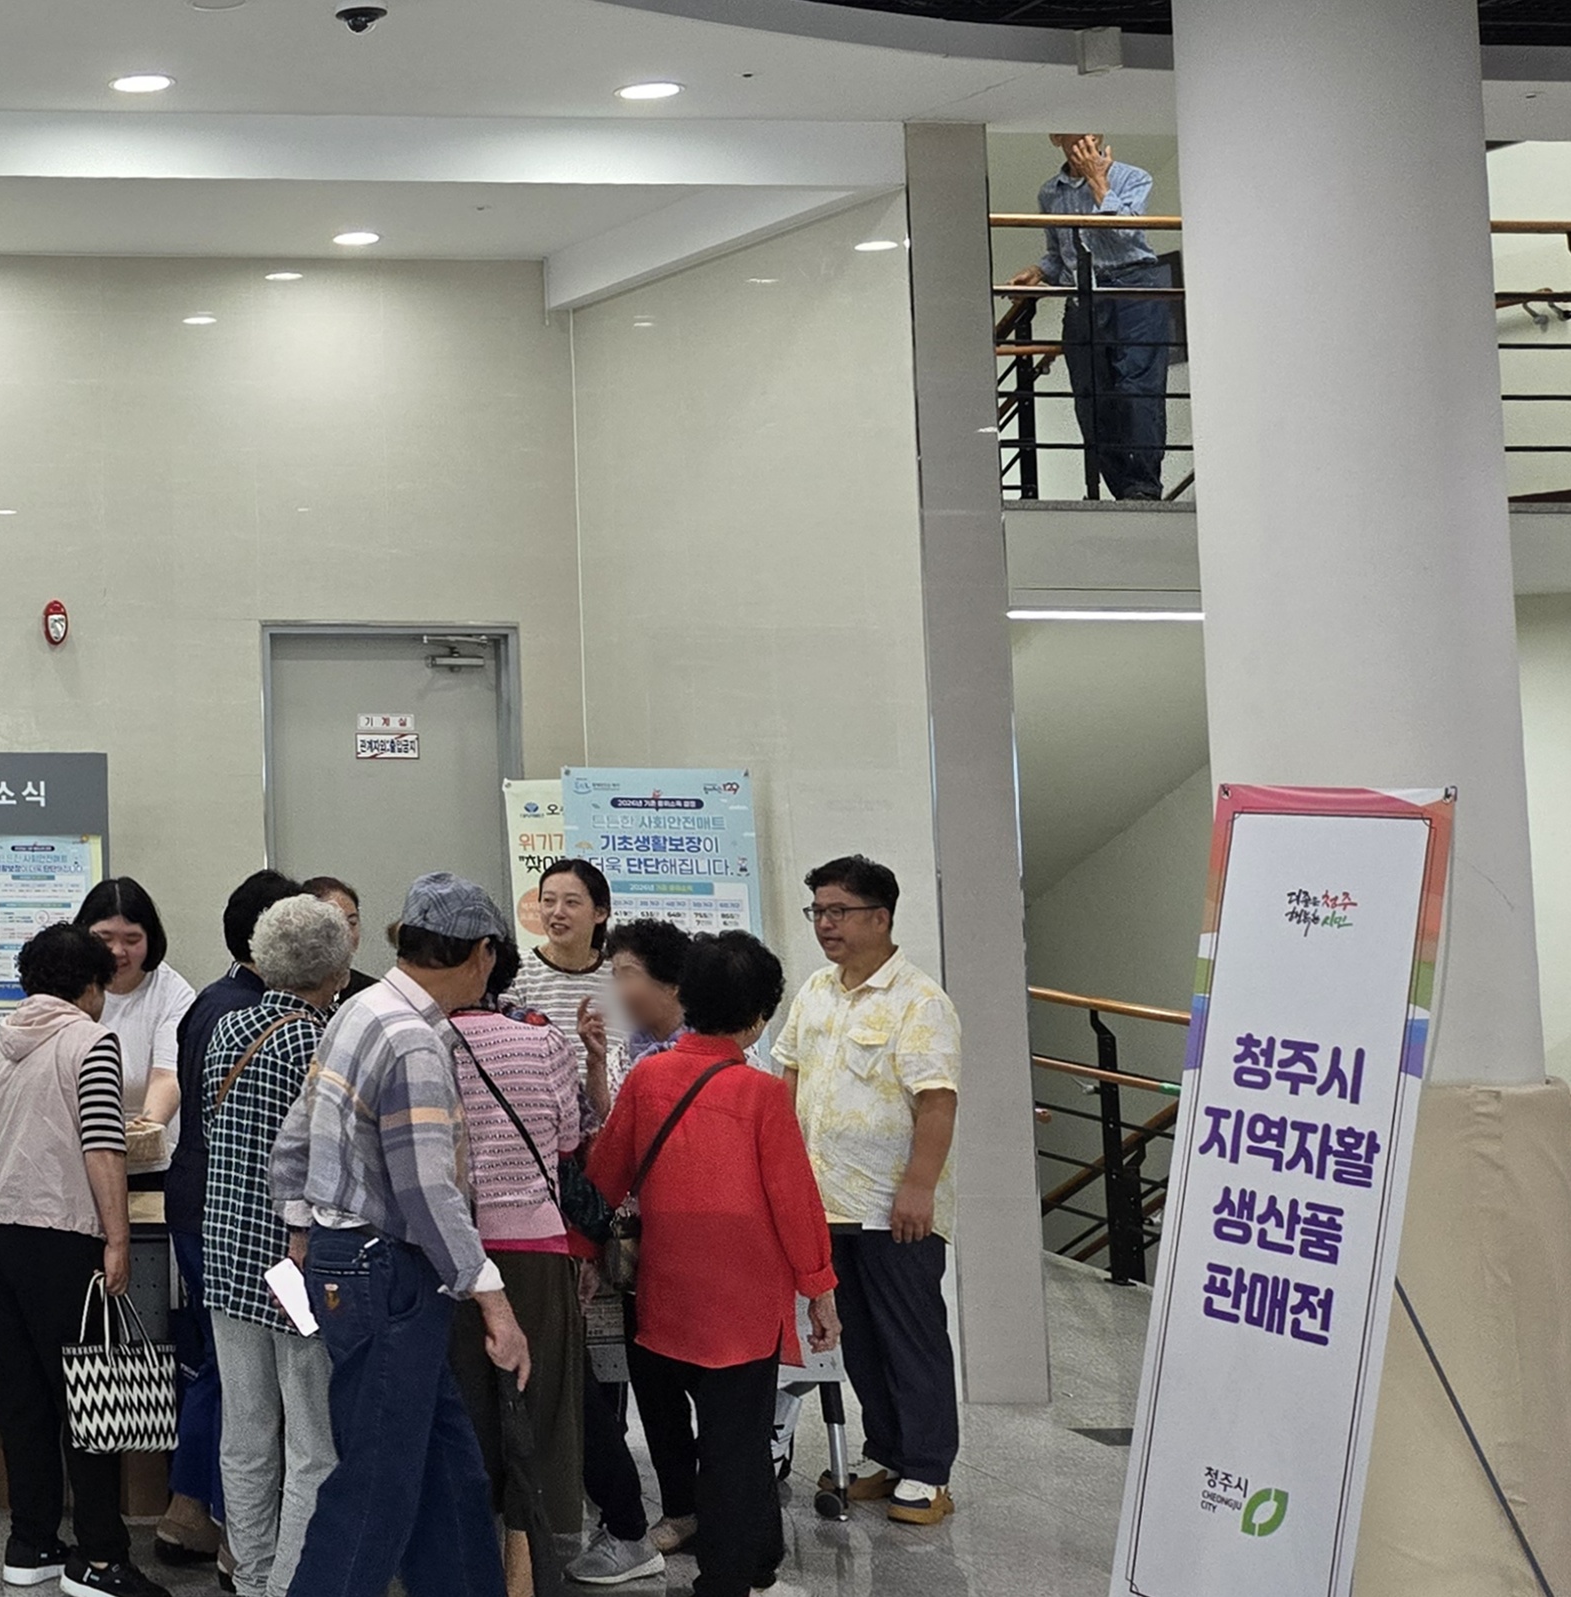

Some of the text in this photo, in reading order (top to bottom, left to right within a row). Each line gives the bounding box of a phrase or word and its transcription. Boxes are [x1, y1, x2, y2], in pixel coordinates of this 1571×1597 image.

[639, 816, 726, 831] 사회안전매트
[600, 834, 720, 853] 기초생활보장이
[1321, 910, 1353, 929] 시민
[1233, 1033, 1365, 1105] 청주시
[1198, 1105, 1381, 1189] 지역자활
[1213, 1186, 1344, 1265] 생산품
[1203, 1262, 1334, 1346] 판매전
[1204, 1466, 1248, 1499] 청주시
[1200, 1500, 1217, 1513] CITY
[1201, 1489, 1243, 1511] CHEONGJU
